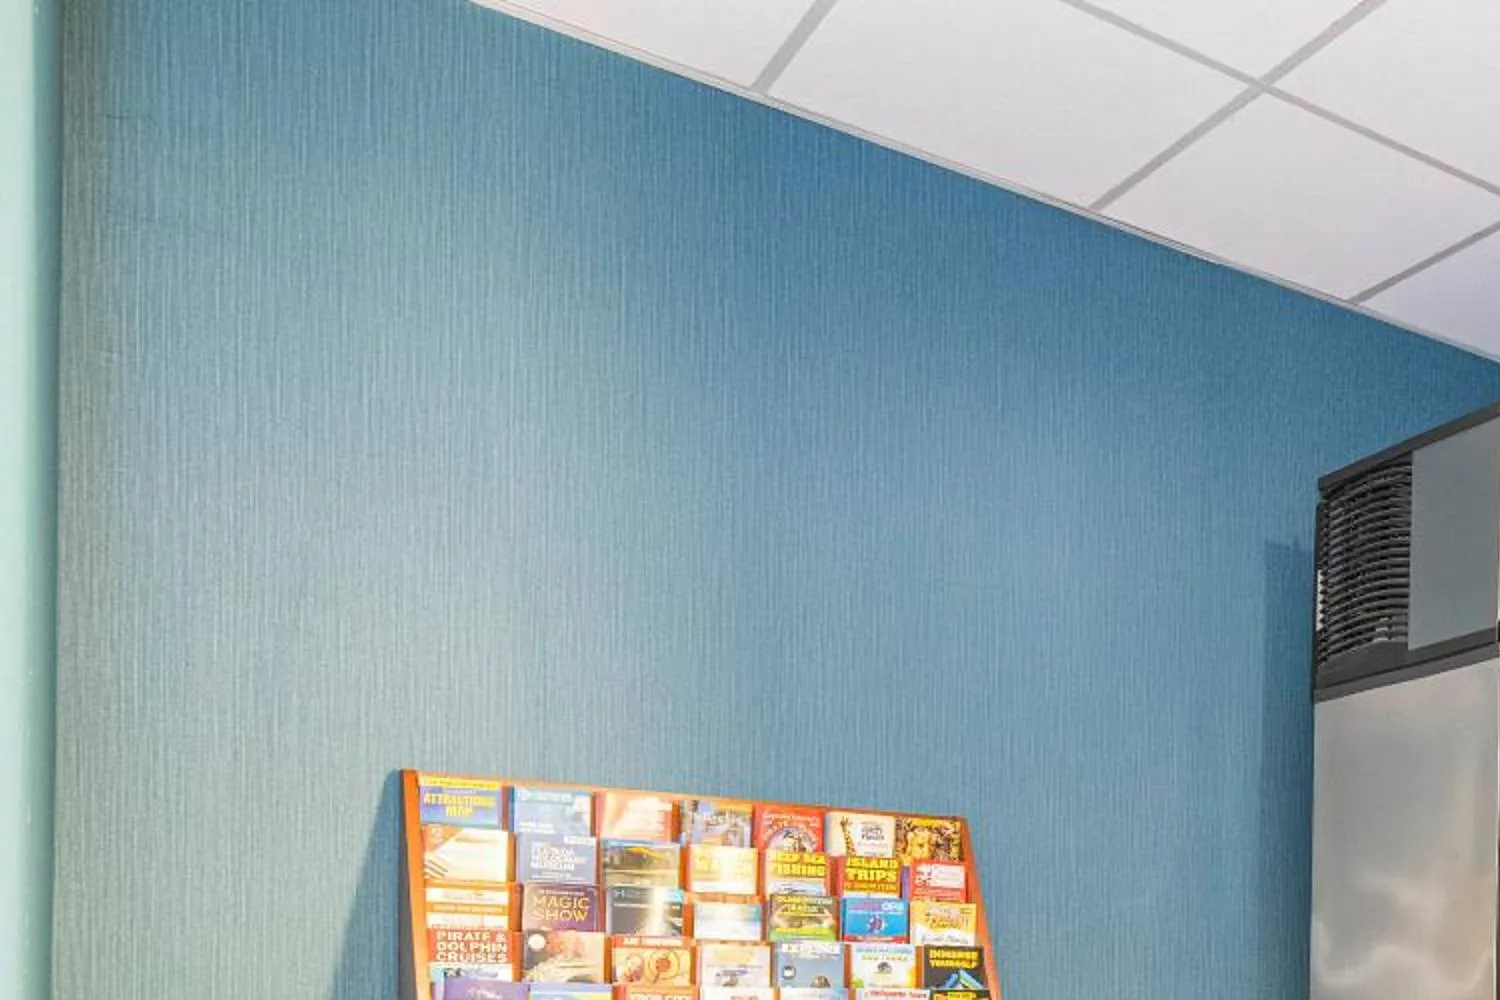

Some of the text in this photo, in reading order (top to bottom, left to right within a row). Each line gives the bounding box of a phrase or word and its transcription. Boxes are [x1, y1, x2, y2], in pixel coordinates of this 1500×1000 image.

[445, 806, 473, 817] MAP
[847, 857, 899, 869] ISLAND
[845, 869, 898, 881] TRIPS
[531, 896, 591, 910] MAGIC
[531, 910, 589, 922] SHOW
[436, 931, 491, 941] PIRATE
[436, 942, 508, 953] DOLPHIN
[435, 953, 508, 963] CRUISES
